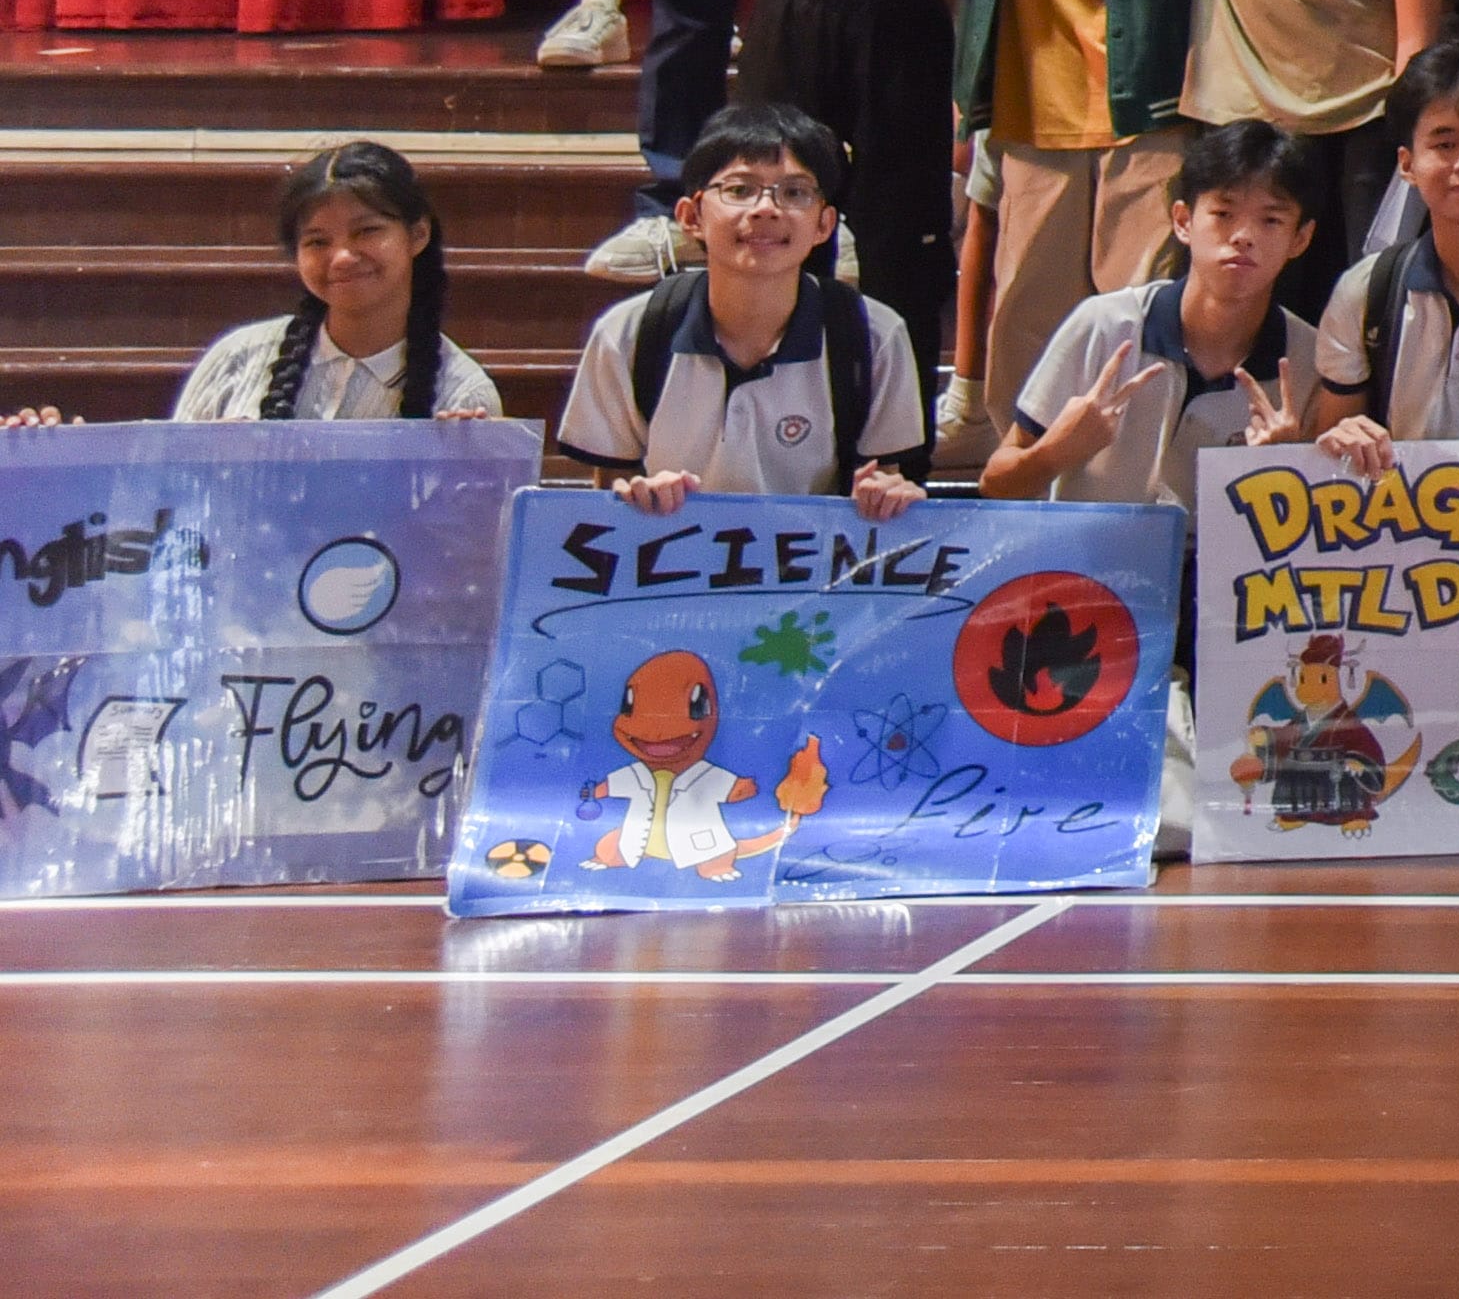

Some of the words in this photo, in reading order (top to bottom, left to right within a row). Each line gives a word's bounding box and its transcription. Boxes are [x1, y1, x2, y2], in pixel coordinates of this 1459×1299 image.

[0, 509, 210, 607] nglish
[551, 522, 971, 597] SCIENCE
[221, 674, 468, 802] Flying
